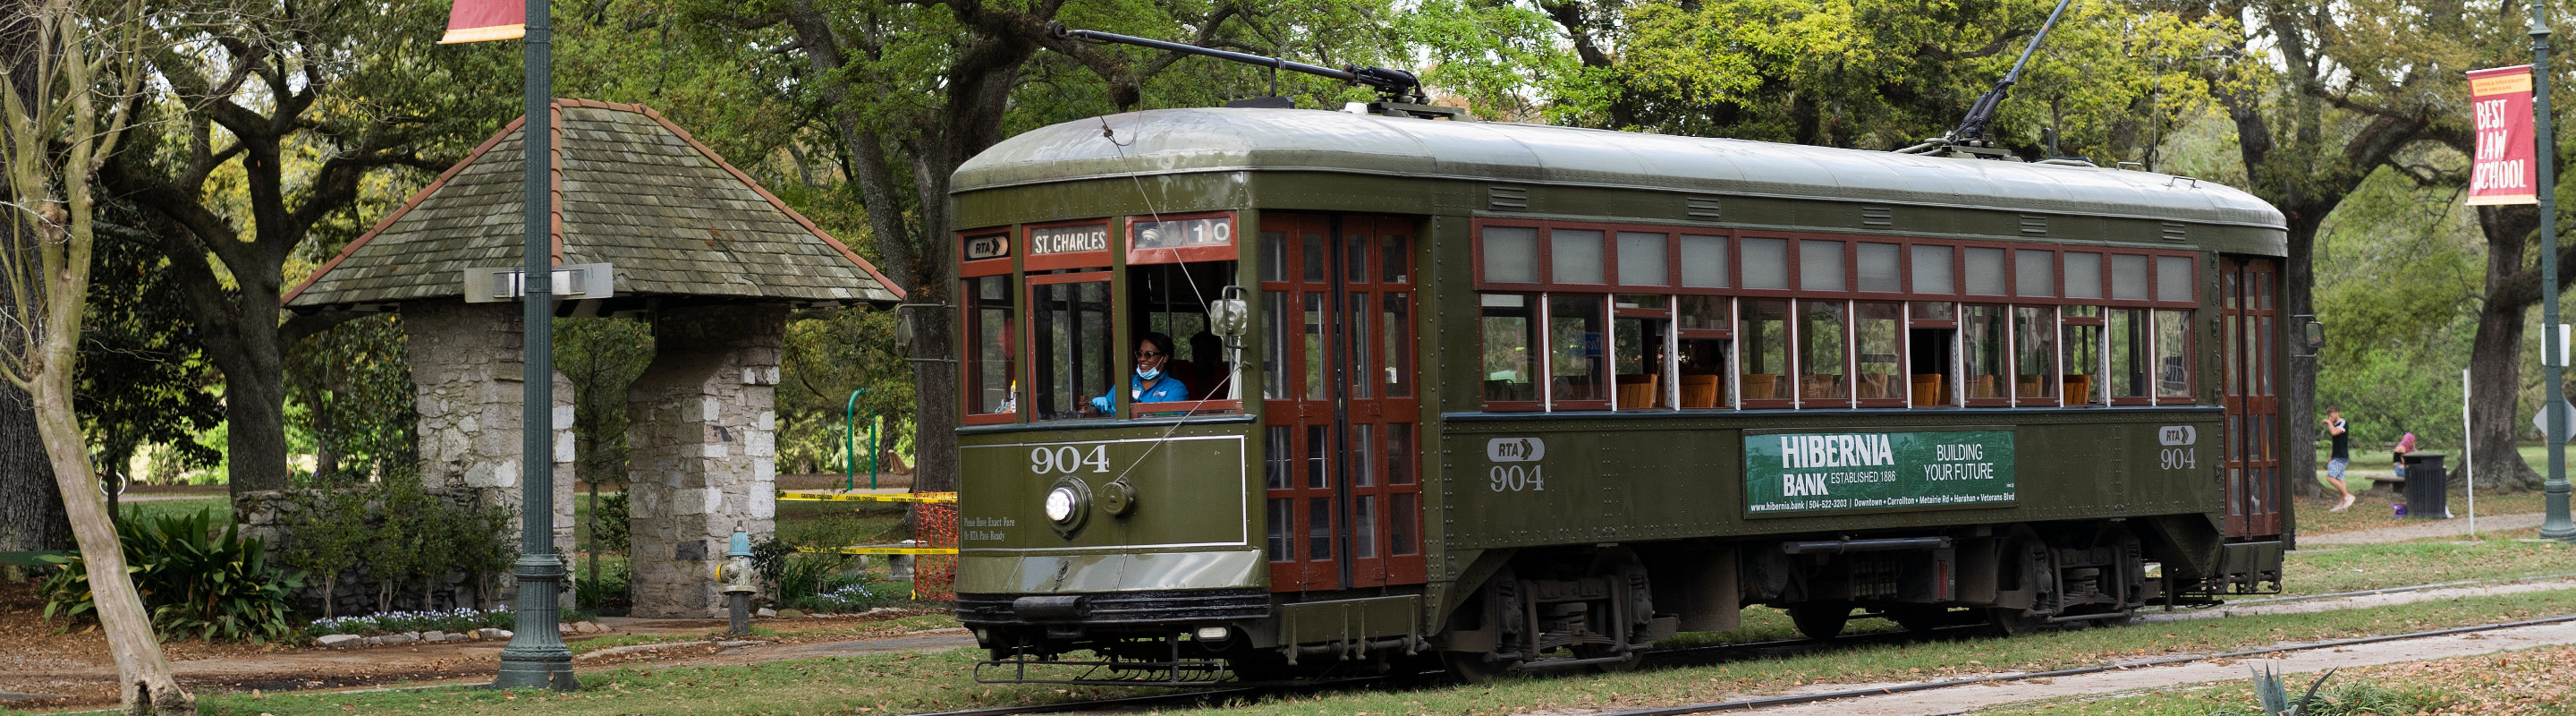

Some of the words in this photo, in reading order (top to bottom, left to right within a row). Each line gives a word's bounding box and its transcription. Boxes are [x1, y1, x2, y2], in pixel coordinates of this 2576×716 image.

[2476, 99, 2507, 131] BEST
[2478, 130, 2507, 159] LAW
[2473, 158, 2526, 190] SCHOOL
[975, 242, 990, 254] RTA
[1035, 234, 1052, 253] ST.
[1053, 231, 1106, 252] CHARLES
[2166, 430, 2180, 441] RTA
[1031, 445, 1110, 474] 904
[1498, 442, 1519, 456] RTA
[1781, 434, 1894, 468] HIBERNIA
[1936, 443, 1983, 461] BUILDING
[2160, 448, 2196, 470] 904
[1490, 465, 1544, 492] 904
[1924, 464, 1953, 481] YOUR
[1954, 463, 1994, 480] FUTURE
[1783, 473, 1829, 497] BANK
[1831, 472, 1878, 484] ESTABLISHED
[1880, 471, 1896, 482] 1886
[1750, 500, 1805, 512] www.hibernia.bank
[1809, 499, 1847, 509] 504-522-3203
[1854, 499, 1882, 507] Downtown
[1886, 496, 1914, 506] Carrollton
[1919, 495, 1942, 504] Metairie
[1942, 494, 1949, 503] Rd
[1953, 494, 1976, 503] Harahan
[1979, 493, 2003, 502] Veterans
[2003, 492, 2015, 501] Blvd
[987, 516, 1002, 526] Exact
[1003, 516, 1015, 526] Fare
[979, 530, 988, 540] Pass
[990, 530, 1004, 542] Ready
